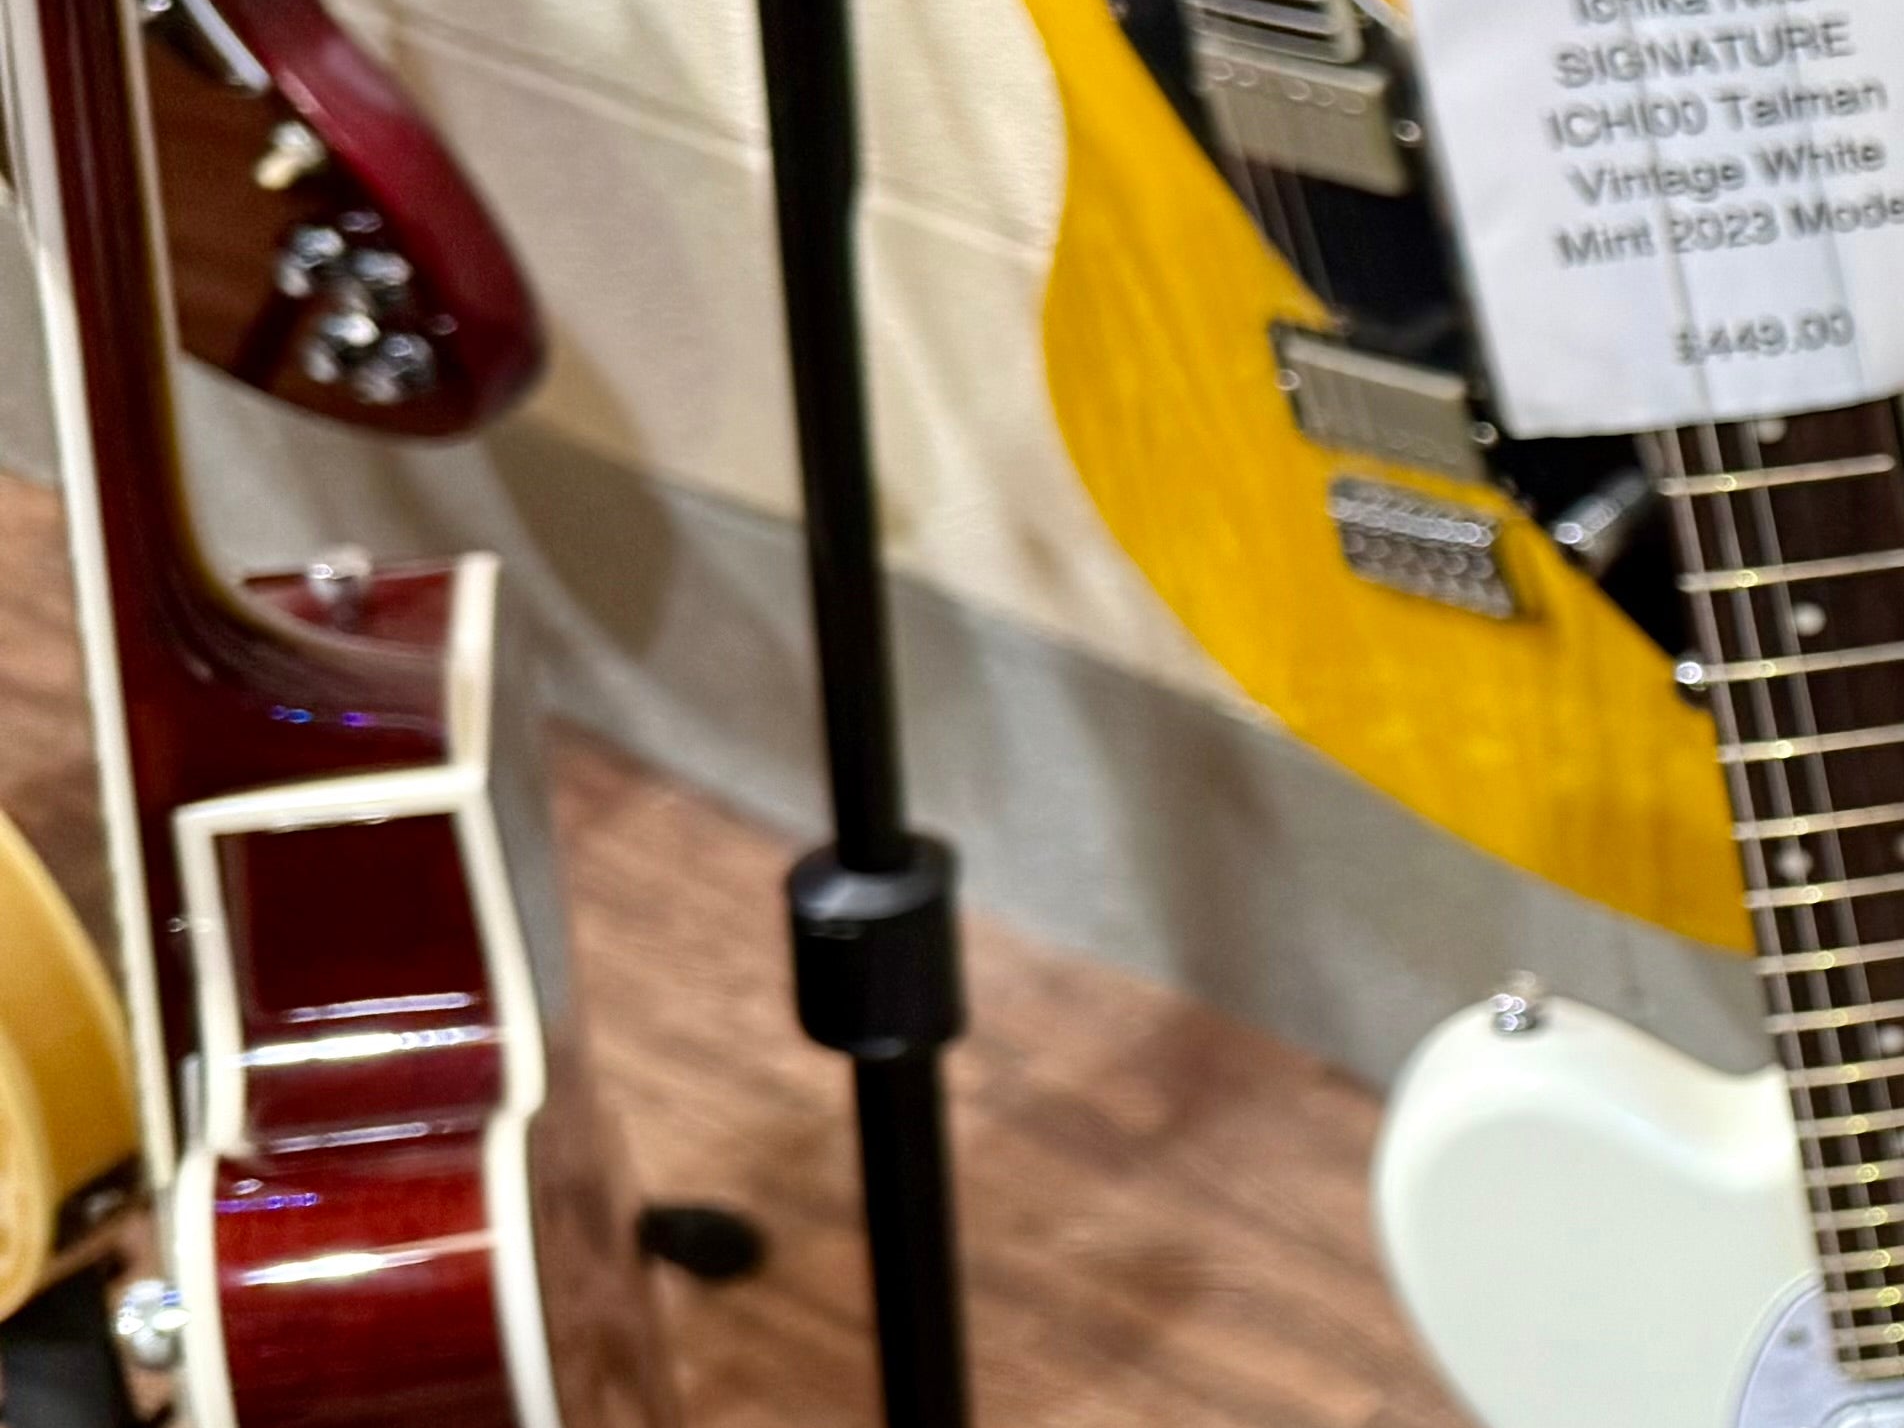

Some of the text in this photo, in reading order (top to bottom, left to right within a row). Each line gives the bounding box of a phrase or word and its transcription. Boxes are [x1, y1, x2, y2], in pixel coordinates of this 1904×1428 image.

[1553, 13, 1856, 89] SIGNATURE
[1712, 78, 1888, 131] Talman
[1568, 137, 1886, 204] Vintage White
[1553, 218, 1656, 270] Mint
[1665, 200, 1778, 254] 2023
